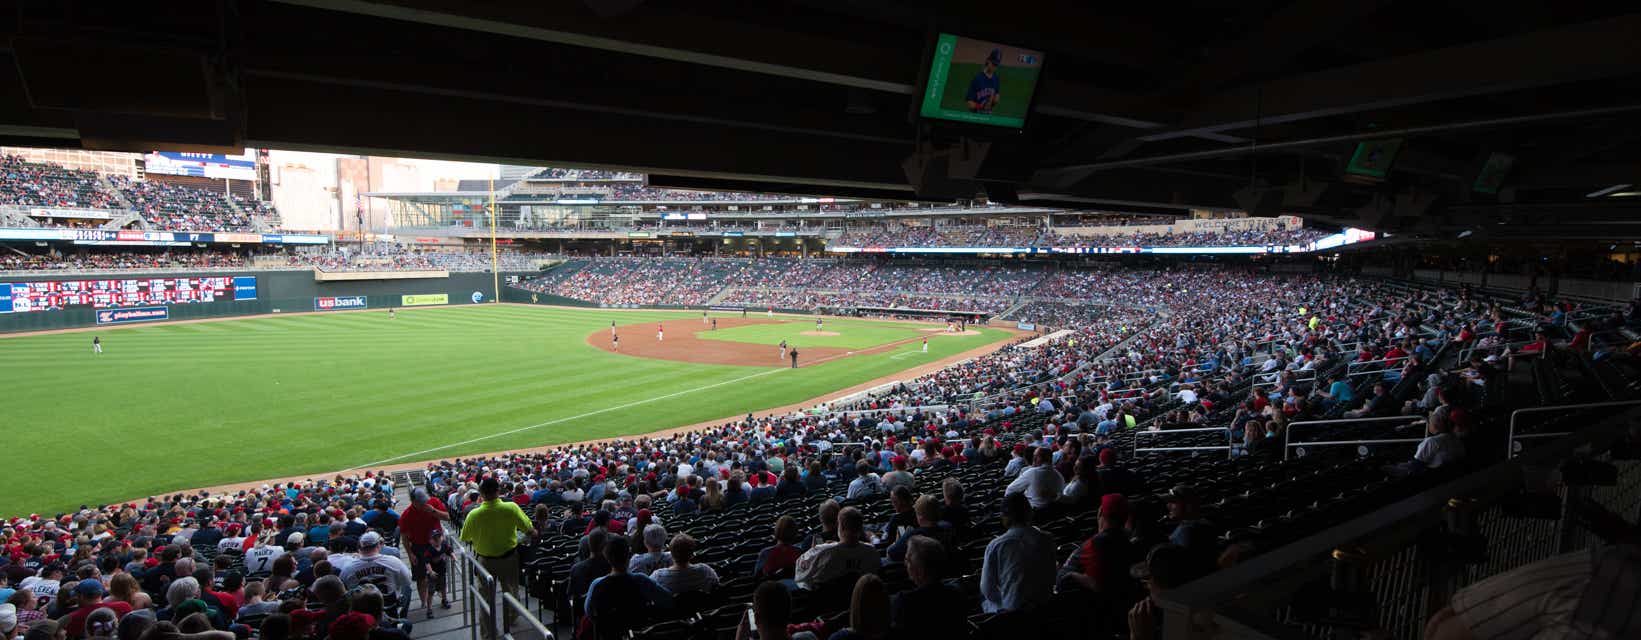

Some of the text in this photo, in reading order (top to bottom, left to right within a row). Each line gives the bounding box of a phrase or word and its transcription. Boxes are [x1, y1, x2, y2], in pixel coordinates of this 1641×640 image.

[1194, 219, 1241, 229] WELCOME
[254, 549, 274, 557] MAUER
[257, 556, 269, 571] 7
